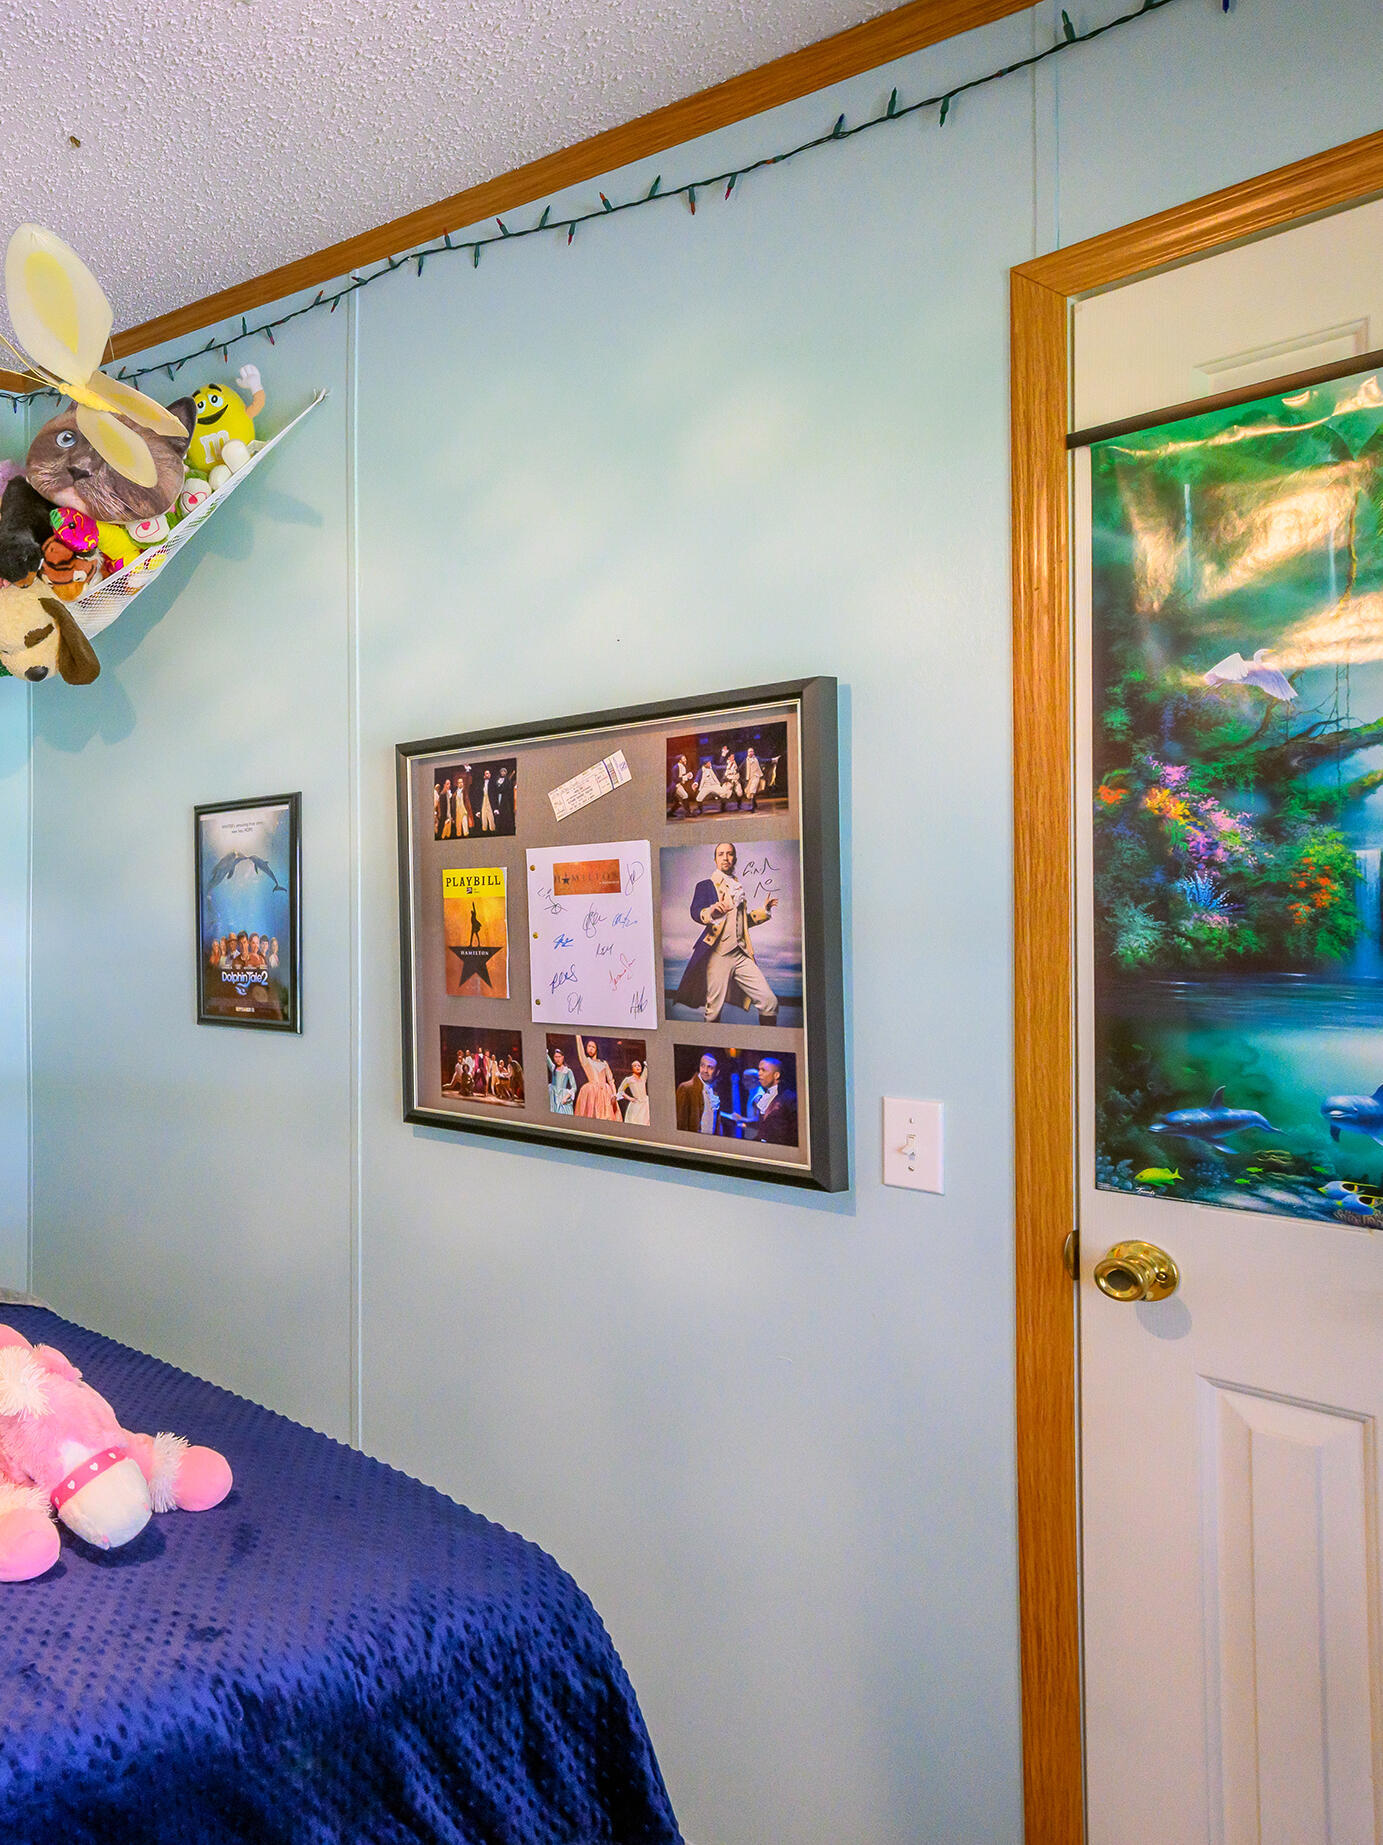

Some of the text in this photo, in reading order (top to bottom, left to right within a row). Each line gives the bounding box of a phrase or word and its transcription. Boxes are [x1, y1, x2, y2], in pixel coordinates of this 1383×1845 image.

[445, 875, 501, 887] PLAYBILL
[222, 971, 248, 984] Dolphin
[261, 970, 269, 985] 2
